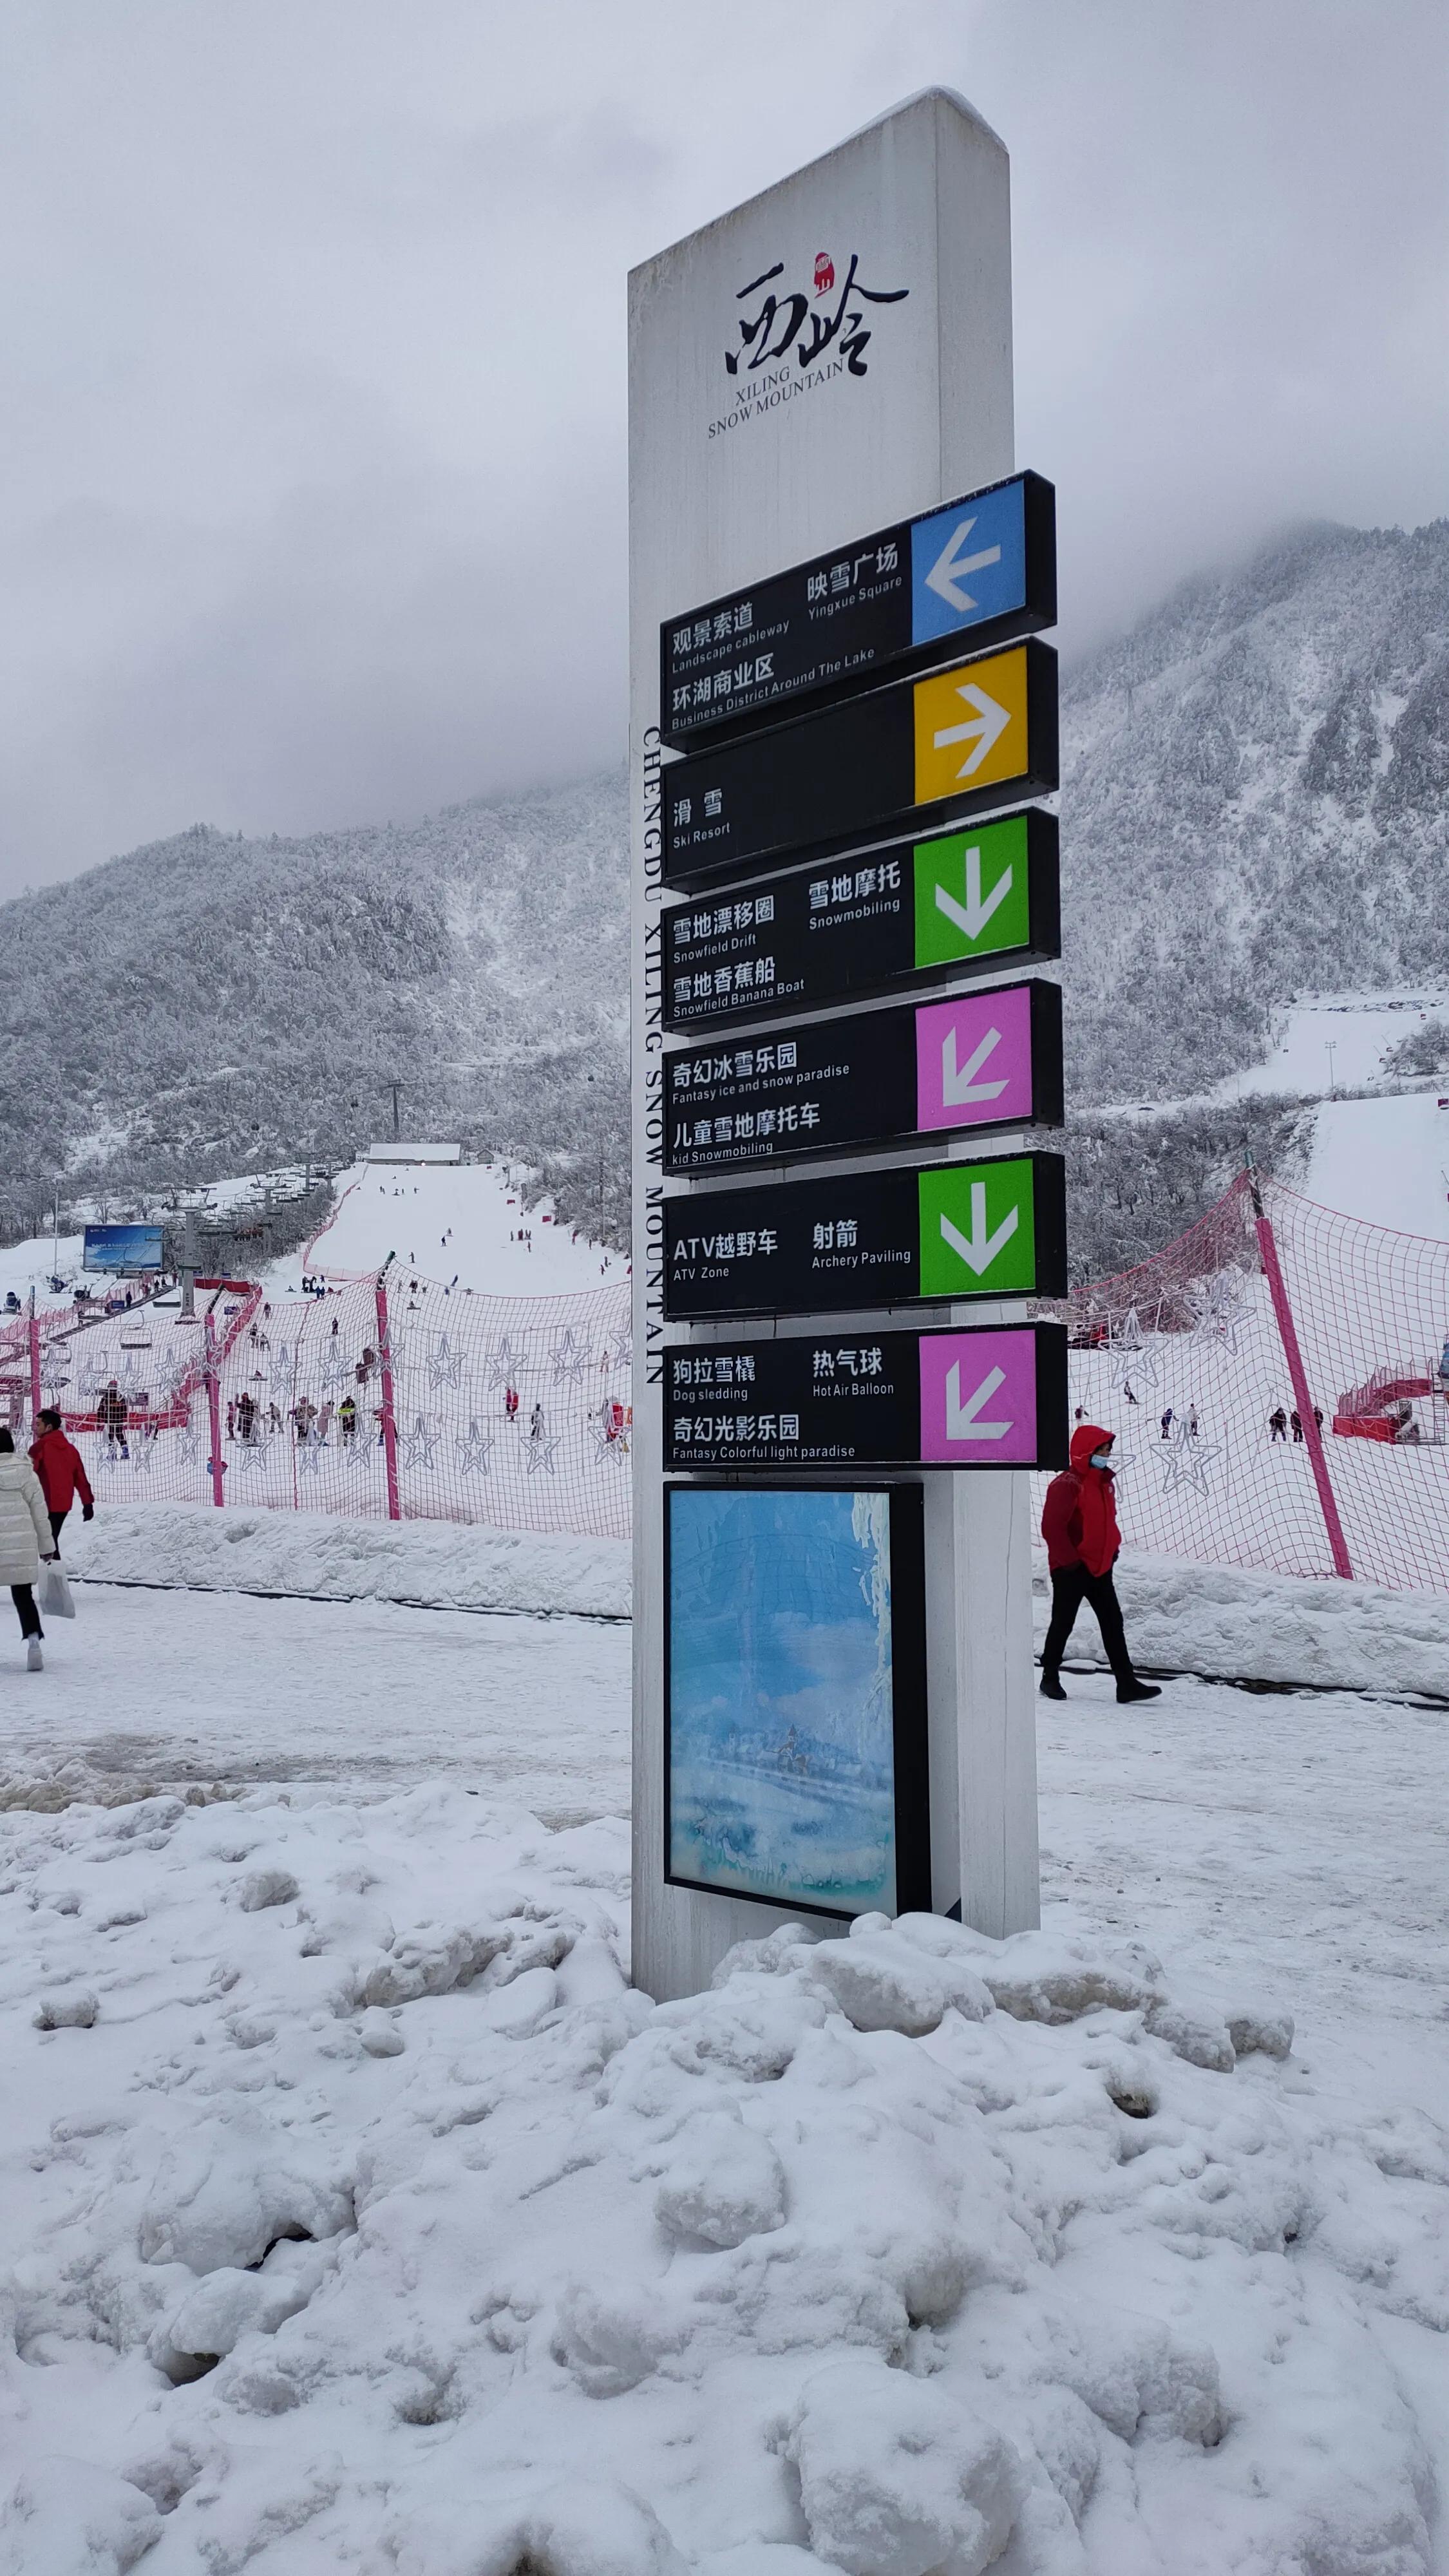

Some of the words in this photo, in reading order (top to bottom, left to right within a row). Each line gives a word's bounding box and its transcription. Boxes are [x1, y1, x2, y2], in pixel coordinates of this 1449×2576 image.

[708, 406, 752, 438] SNOW
[757, 359, 843, 416] MOUNTAIN
[735, 366, 790, 406] XILING
[808, 543, 898, 601] 映雪广场
[809, 596, 855, 620] Yingxue
[859, 577, 902, 600] Square
[673, 602, 753, 654] 观景索道
[673, 644, 732, 673] Landscape
[735, 620, 790, 649] cableway
[672, 705, 723, 730] Business
[727, 686, 769, 710] District
[772, 668, 815, 694] Around
[819, 661, 840, 676] The
[845, 649, 875, 667] Lake
[673, 653, 774, 712] 环湖商业区
[644, 726, 661, 902] CHENGDU
[674, 834, 690, 849] Ski
[694, 822, 730, 842] Resort
[809, 861, 900, 910] 雪地摩托
[674, 895, 773, 945] 雪地漂移圈
[810, 899, 900, 930] Snowmobiling
[674, 940, 728, 963] Snowfield
[732, 933, 757, 950] Drift
[645, 923, 663, 1053] XILING
[674, 956, 775, 1003] 雪地香蕉船
[674, 994, 728, 1018] Snowfield
[732, 987, 773, 1005] Banana
[777, 979, 804, 995] Boat
[673, 1042, 797, 1088] 奇幻冰雪乐园
[673, 1085, 715, 1104] Fantasy
[719, 1083, 735, 1096] ice
[739, 1079, 759, 1093] and
[762, 1074, 793, 1088] snow
[797, 1065, 849, 1086] paradise
[646, 1070, 663, 1166] SNOW
[674, 1102, 820, 1149] 儿童雪地摩托车
[673, 1151, 688, 1165] kid
[692, 1142, 773, 1162] Snowmobiling
[674, 1229, 777, 1260] ATV越野车
[813, 1220, 858, 1250] 射箭
[674, 1268, 695, 1281] ATV
[701, 1267, 729, 1278] Zone
[812, 1251, 858, 1269] Archery
[862, 1249, 911, 1264] Paviling
[646, 1185, 663, 1383] MOUNTAIN
[674, 1356, 755, 1385] 狗拉雪橇
[813, 1348, 882, 1378] 热气球
[674, 1390, 695, 1403] Dog
[699, 1387, 748, 1401] sledding
[813, 1385, 831, 1396] Hot
[834, 1384, 848, 1396] Air
[852, 1383, 894, 1395] Balloon
[674, 1414, 799, 1442] 奇幻光影乐园
[674, 1447, 717, 1461] Fantasy
[720, 1445, 767, 1458] Colorful
[772, 1444, 798, 1458] light
[801, 1445, 855, 1459] paradise
